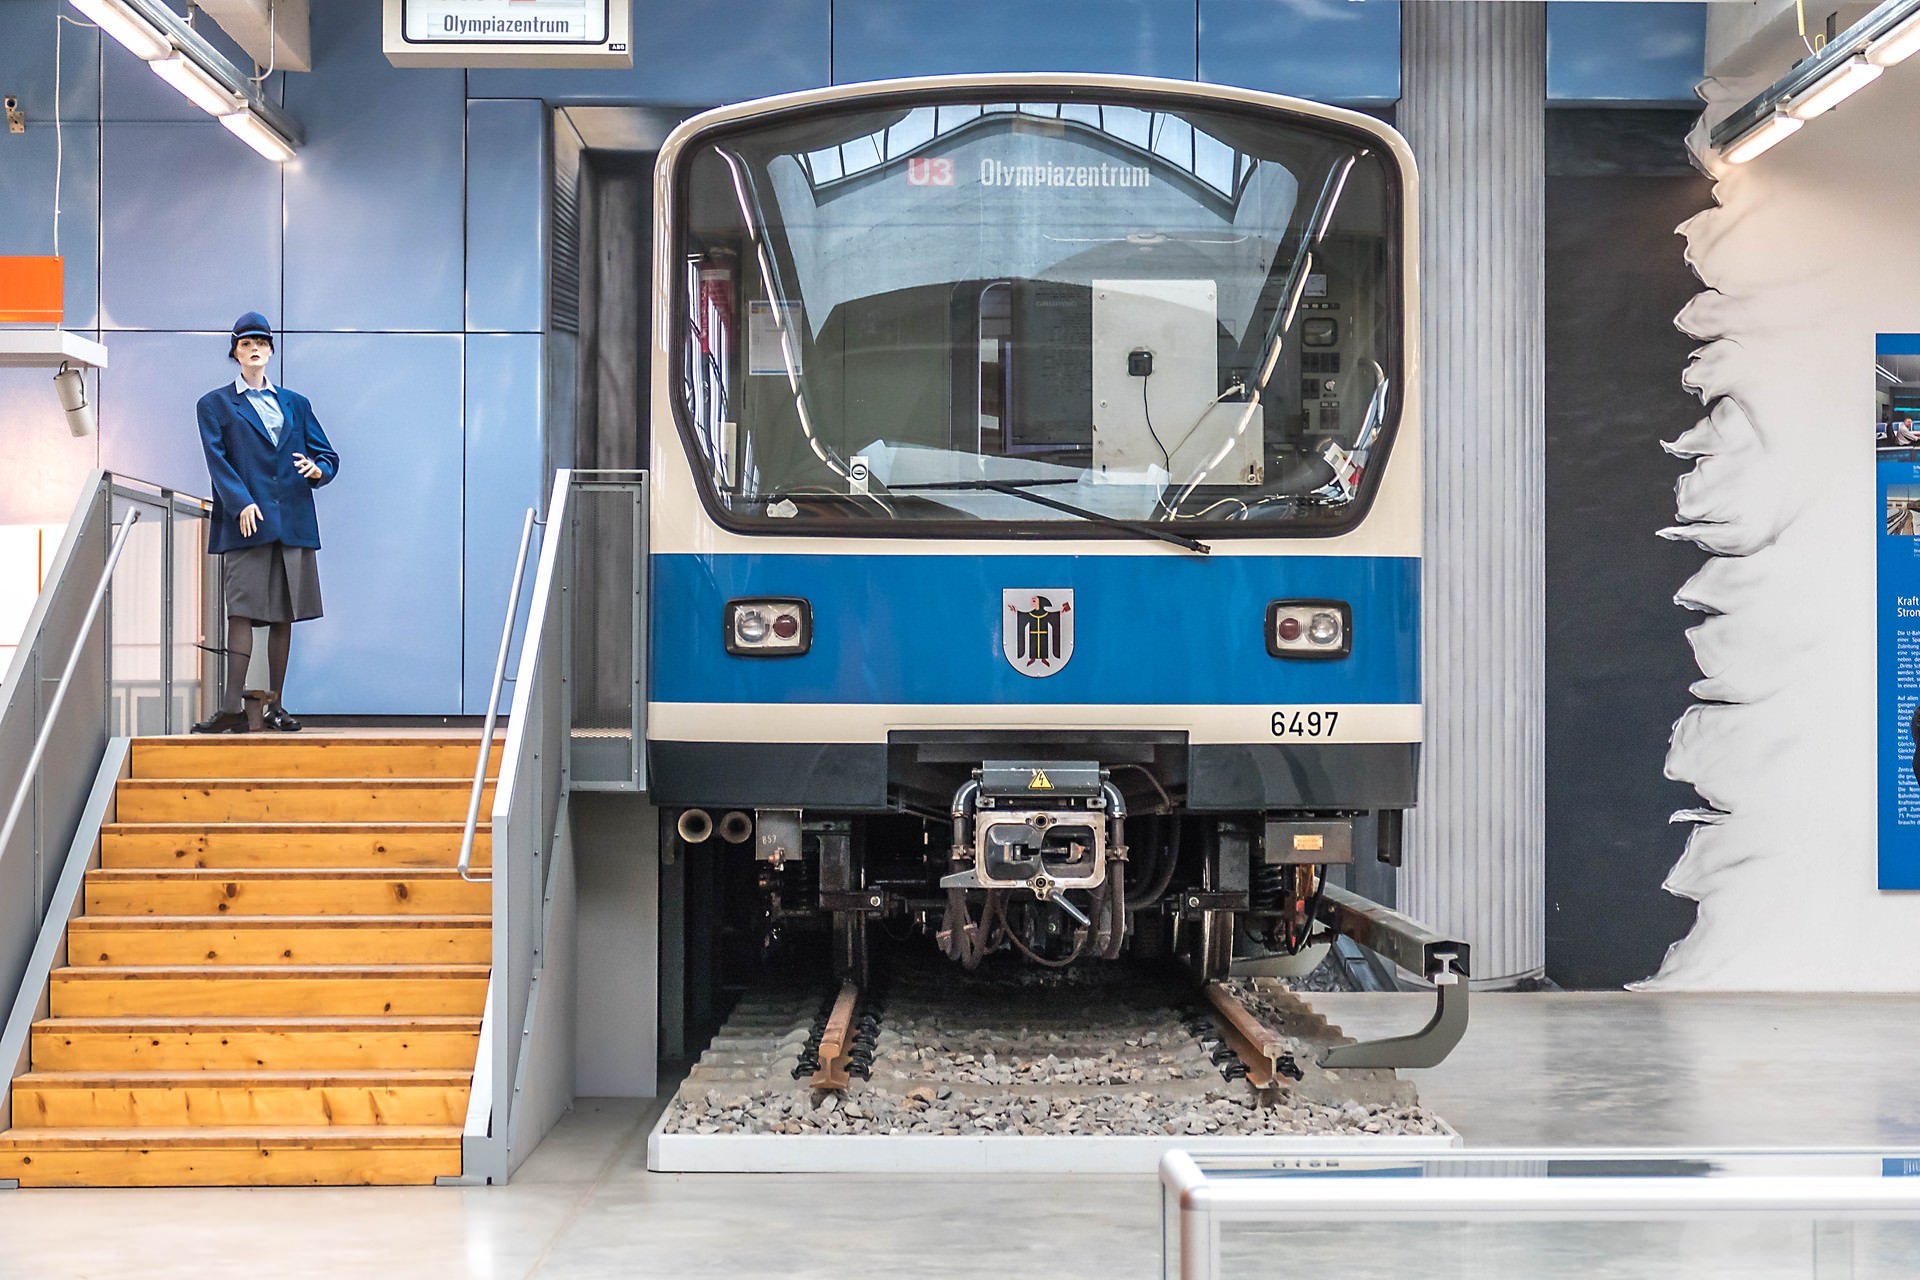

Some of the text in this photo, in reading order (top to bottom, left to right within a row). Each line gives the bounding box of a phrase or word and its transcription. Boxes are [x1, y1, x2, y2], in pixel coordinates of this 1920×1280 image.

[444, 14, 569, 35] Olympiazentrum
[909, 158, 1150, 187] U3 Olympiazentrum
[1897, 596, 1919, 606] Kraft
[1271, 711, 1339, 737] 6497
